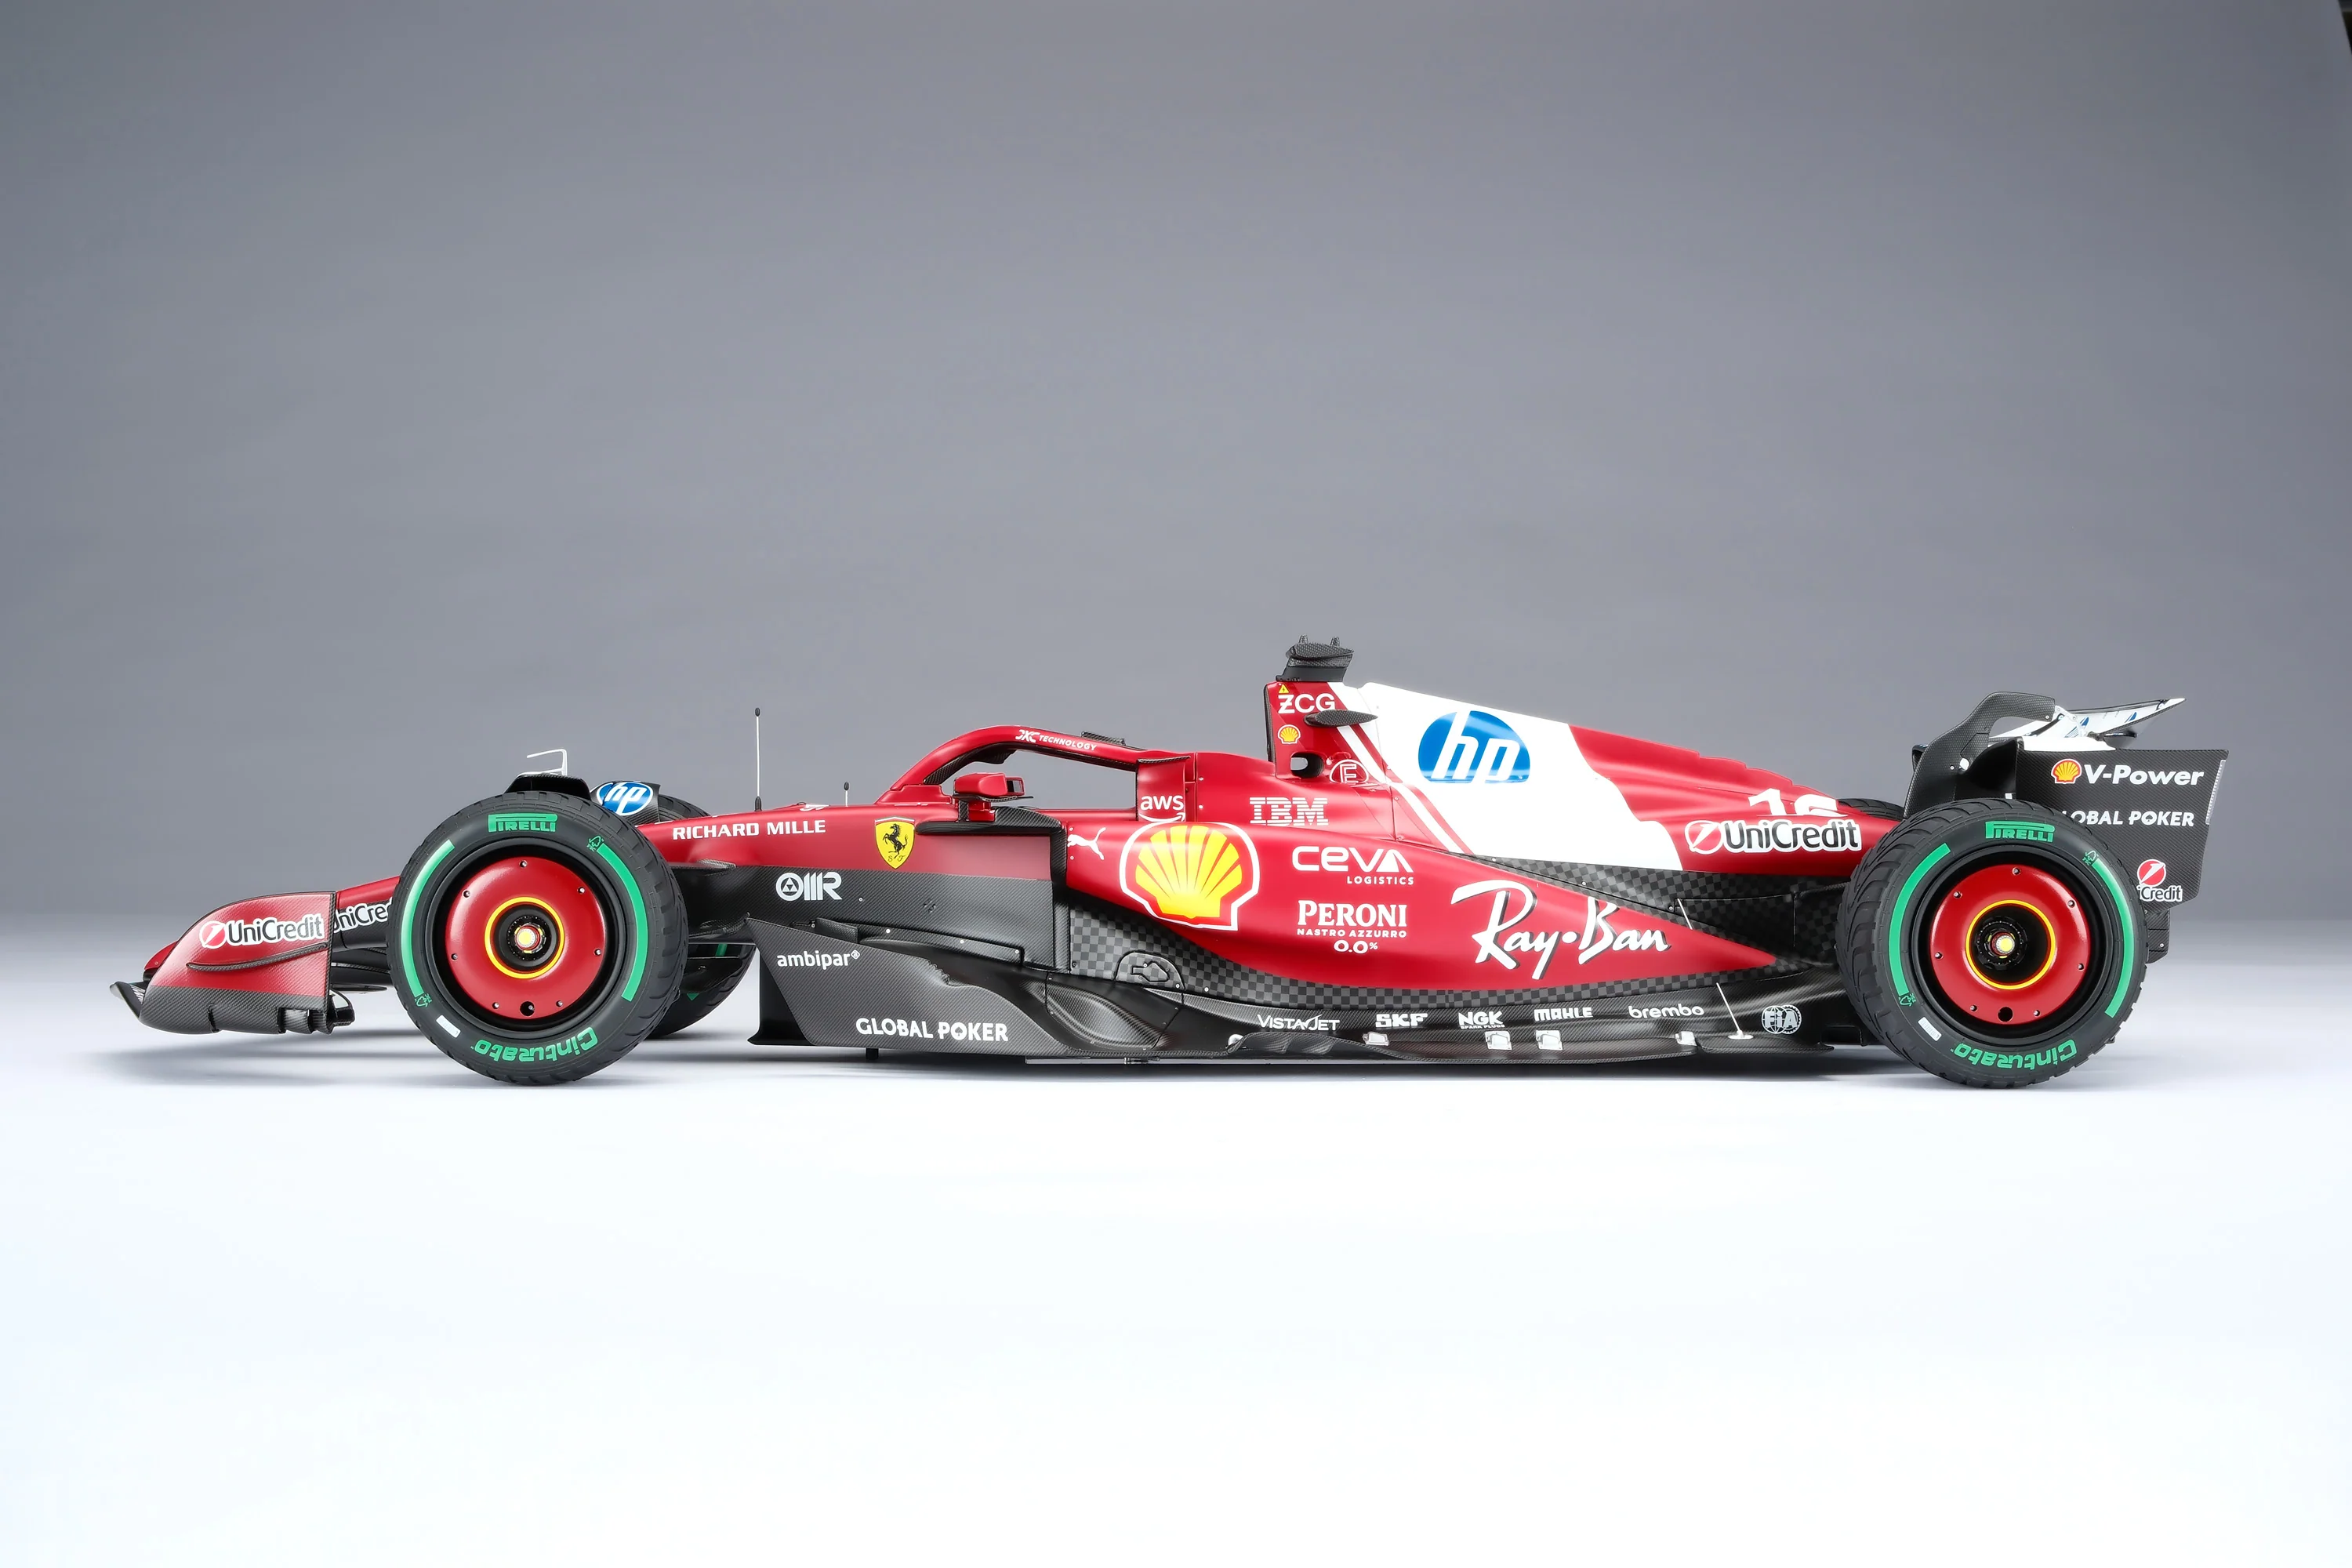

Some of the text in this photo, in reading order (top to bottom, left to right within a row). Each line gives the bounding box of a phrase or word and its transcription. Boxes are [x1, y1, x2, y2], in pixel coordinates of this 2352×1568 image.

[1278, 693, 1335, 713] ZCG
[1039, 735, 1097, 751] TECHNOLOGY
[1431, 710, 1520, 783] hp
[2084, 764, 2205, 785] V-Power
[604, 782, 648, 815] hp
[1140, 795, 1185, 811] aws
[1250, 797, 1329, 826] IBM
[2129, 811, 2194, 826] POKER
[488, 813, 558, 833] PIRELLI
[673, 820, 826, 840] RICHARD MILLE
[1985, 820, 2055, 843] PIRELLI
[1725, 821, 1859, 849] UniCredit
[1347, 876, 1414, 885] LOGISTICS
[2138, 887, 2181, 901] iCredit
[1298, 900, 1407, 927] PERONI
[228, 915, 323, 944] UniCredit
[1297, 928, 1407, 938] NASTRO AZZURRO
[1334, 939, 1378, 954] 0.0%
[776, 950, 851, 971] ambipar
[1375, 1013, 1428, 1029] SKF
[1458, 1011, 1504, 1025] NGK
[1534, 1007, 1594, 1022] MAHLE
[1628, 1004, 1704, 1018] brembo
[855, 1018, 1009, 1042] GLOBAL POKER
